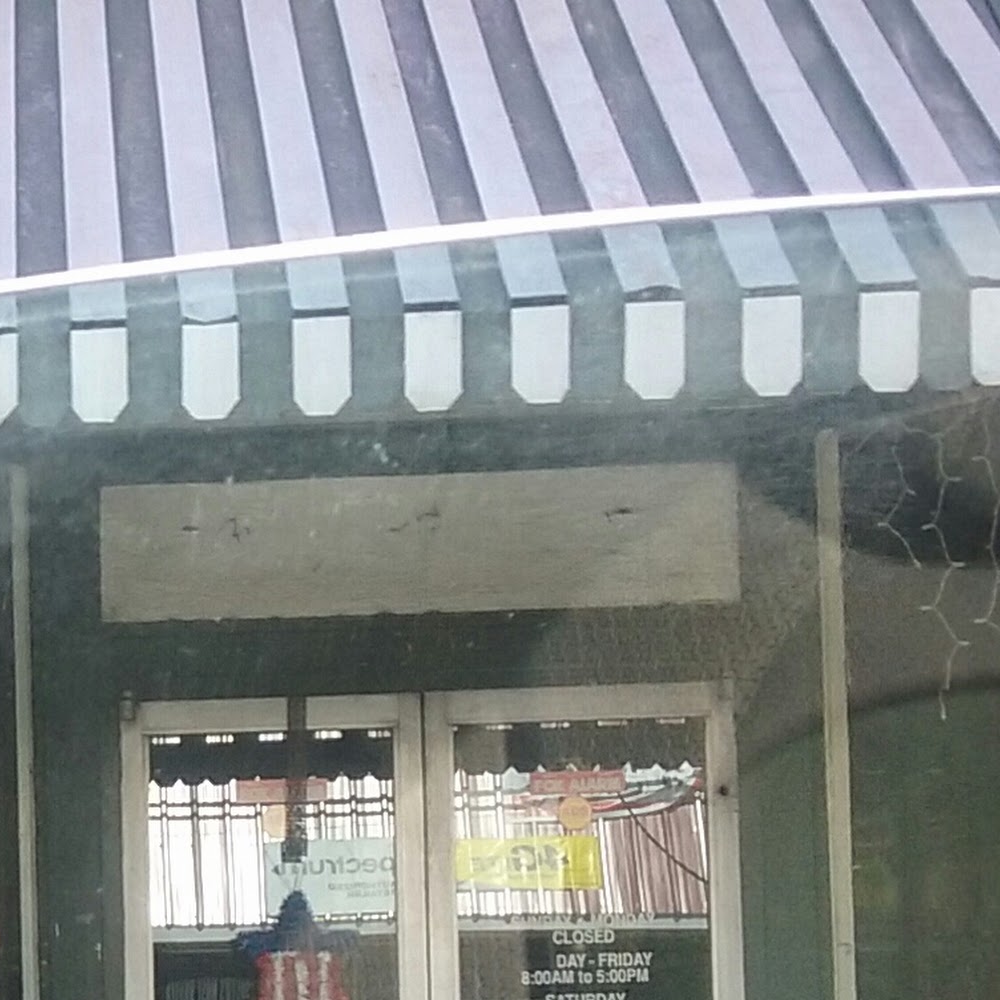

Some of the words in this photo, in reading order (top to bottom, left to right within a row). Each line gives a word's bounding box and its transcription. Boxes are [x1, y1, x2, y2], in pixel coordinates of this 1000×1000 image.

[552, 930, 615, 945] CLOSED
[556, 954, 587, 968] DAY
[598, 952, 653, 967] FRIDAY
[521, 970, 574, 985] 8:00AM
[577, 971, 593, 984] to
[596, 969, 649, 984] 5:00PM
